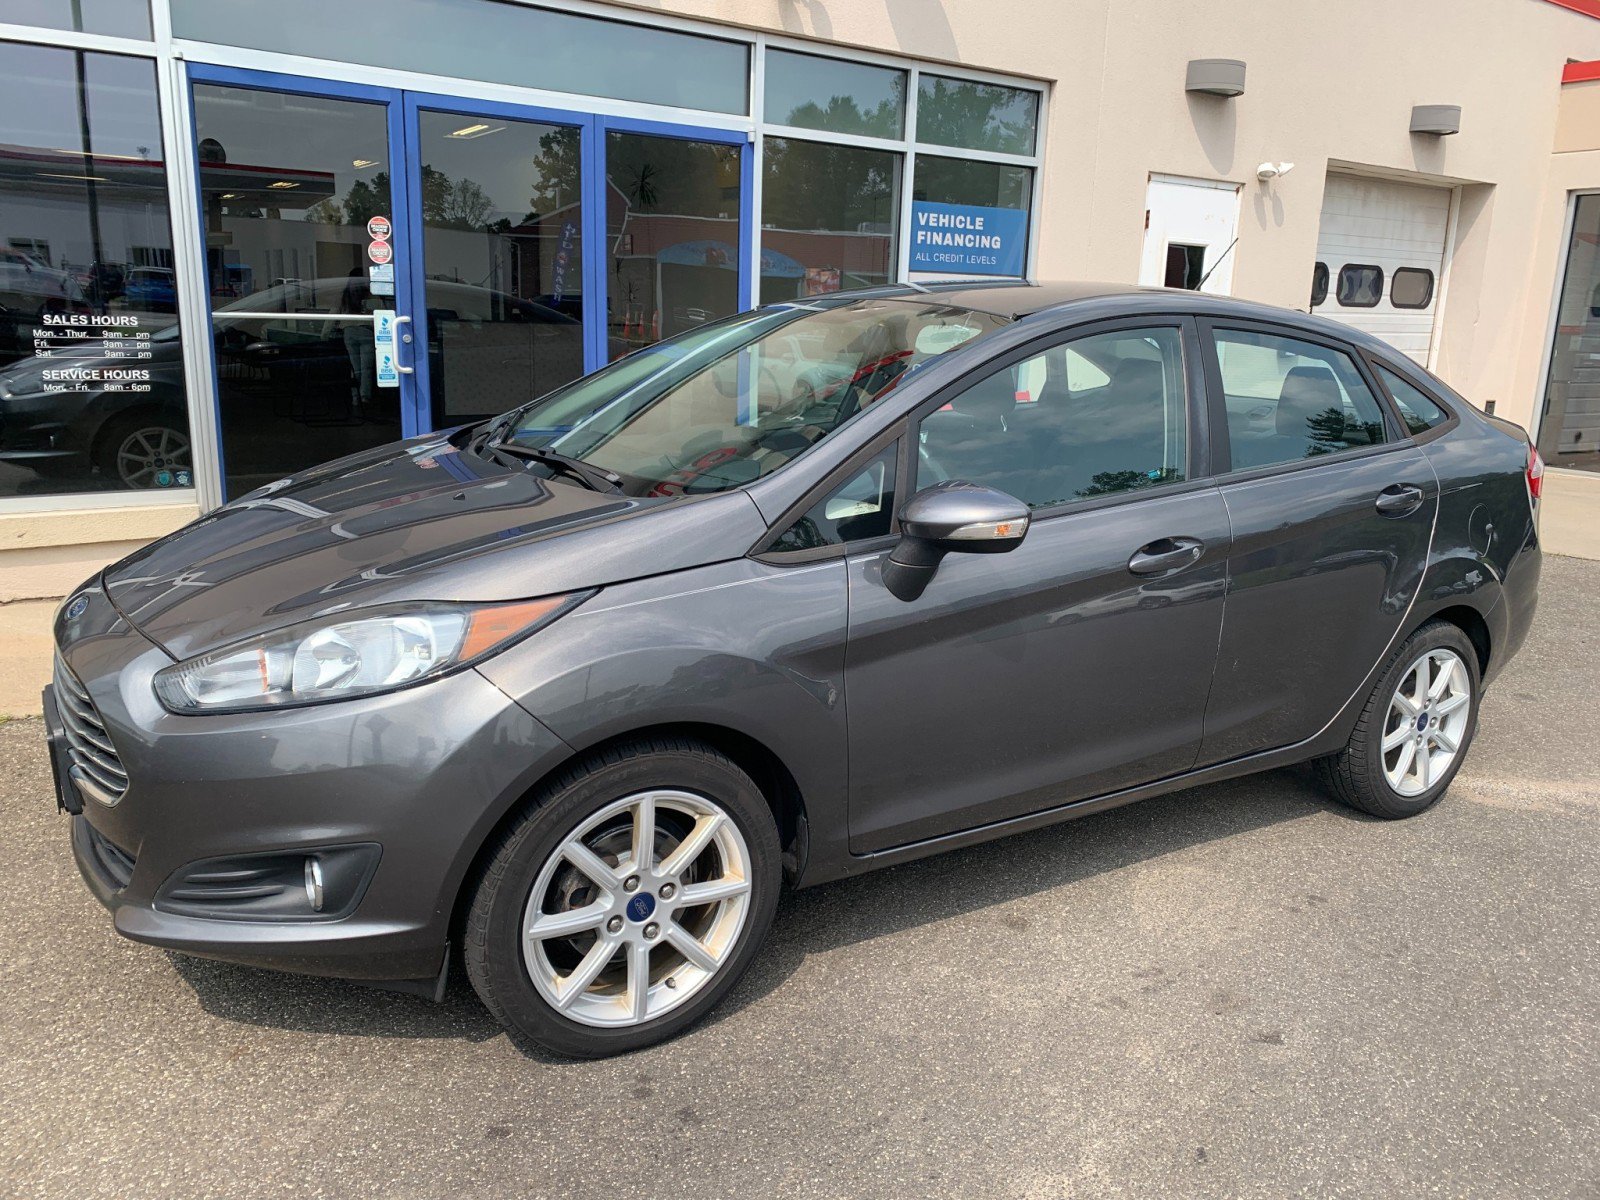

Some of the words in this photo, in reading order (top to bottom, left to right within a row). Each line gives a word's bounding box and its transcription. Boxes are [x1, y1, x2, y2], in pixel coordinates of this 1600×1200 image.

[917, 212, 984, 230] VEHICLE
[917, 231, 1001, 249] FINANCING
[915, 252, 931, 261] ALL
[933, 253, 964, 263] CREDIT
[966, 255, 997, 265] LEVELS
[43, 314, 88, 325] SALES
[91, 316, 138, 326] HOURS
[33, 329, 57, 338] Mon.
[65, 330, 90, 338] Thur.
[102, 330, 123, 338] 9am
[34, 339, 50, 347] Fri.
[103, 340, 123, 348] 9am
[104, 350, 125, 358] 9am
[42, 370, 100, 380] SERVICE
[104, 370, 150, 380] HOURS
[131, 384, 151, 392] 6pm
